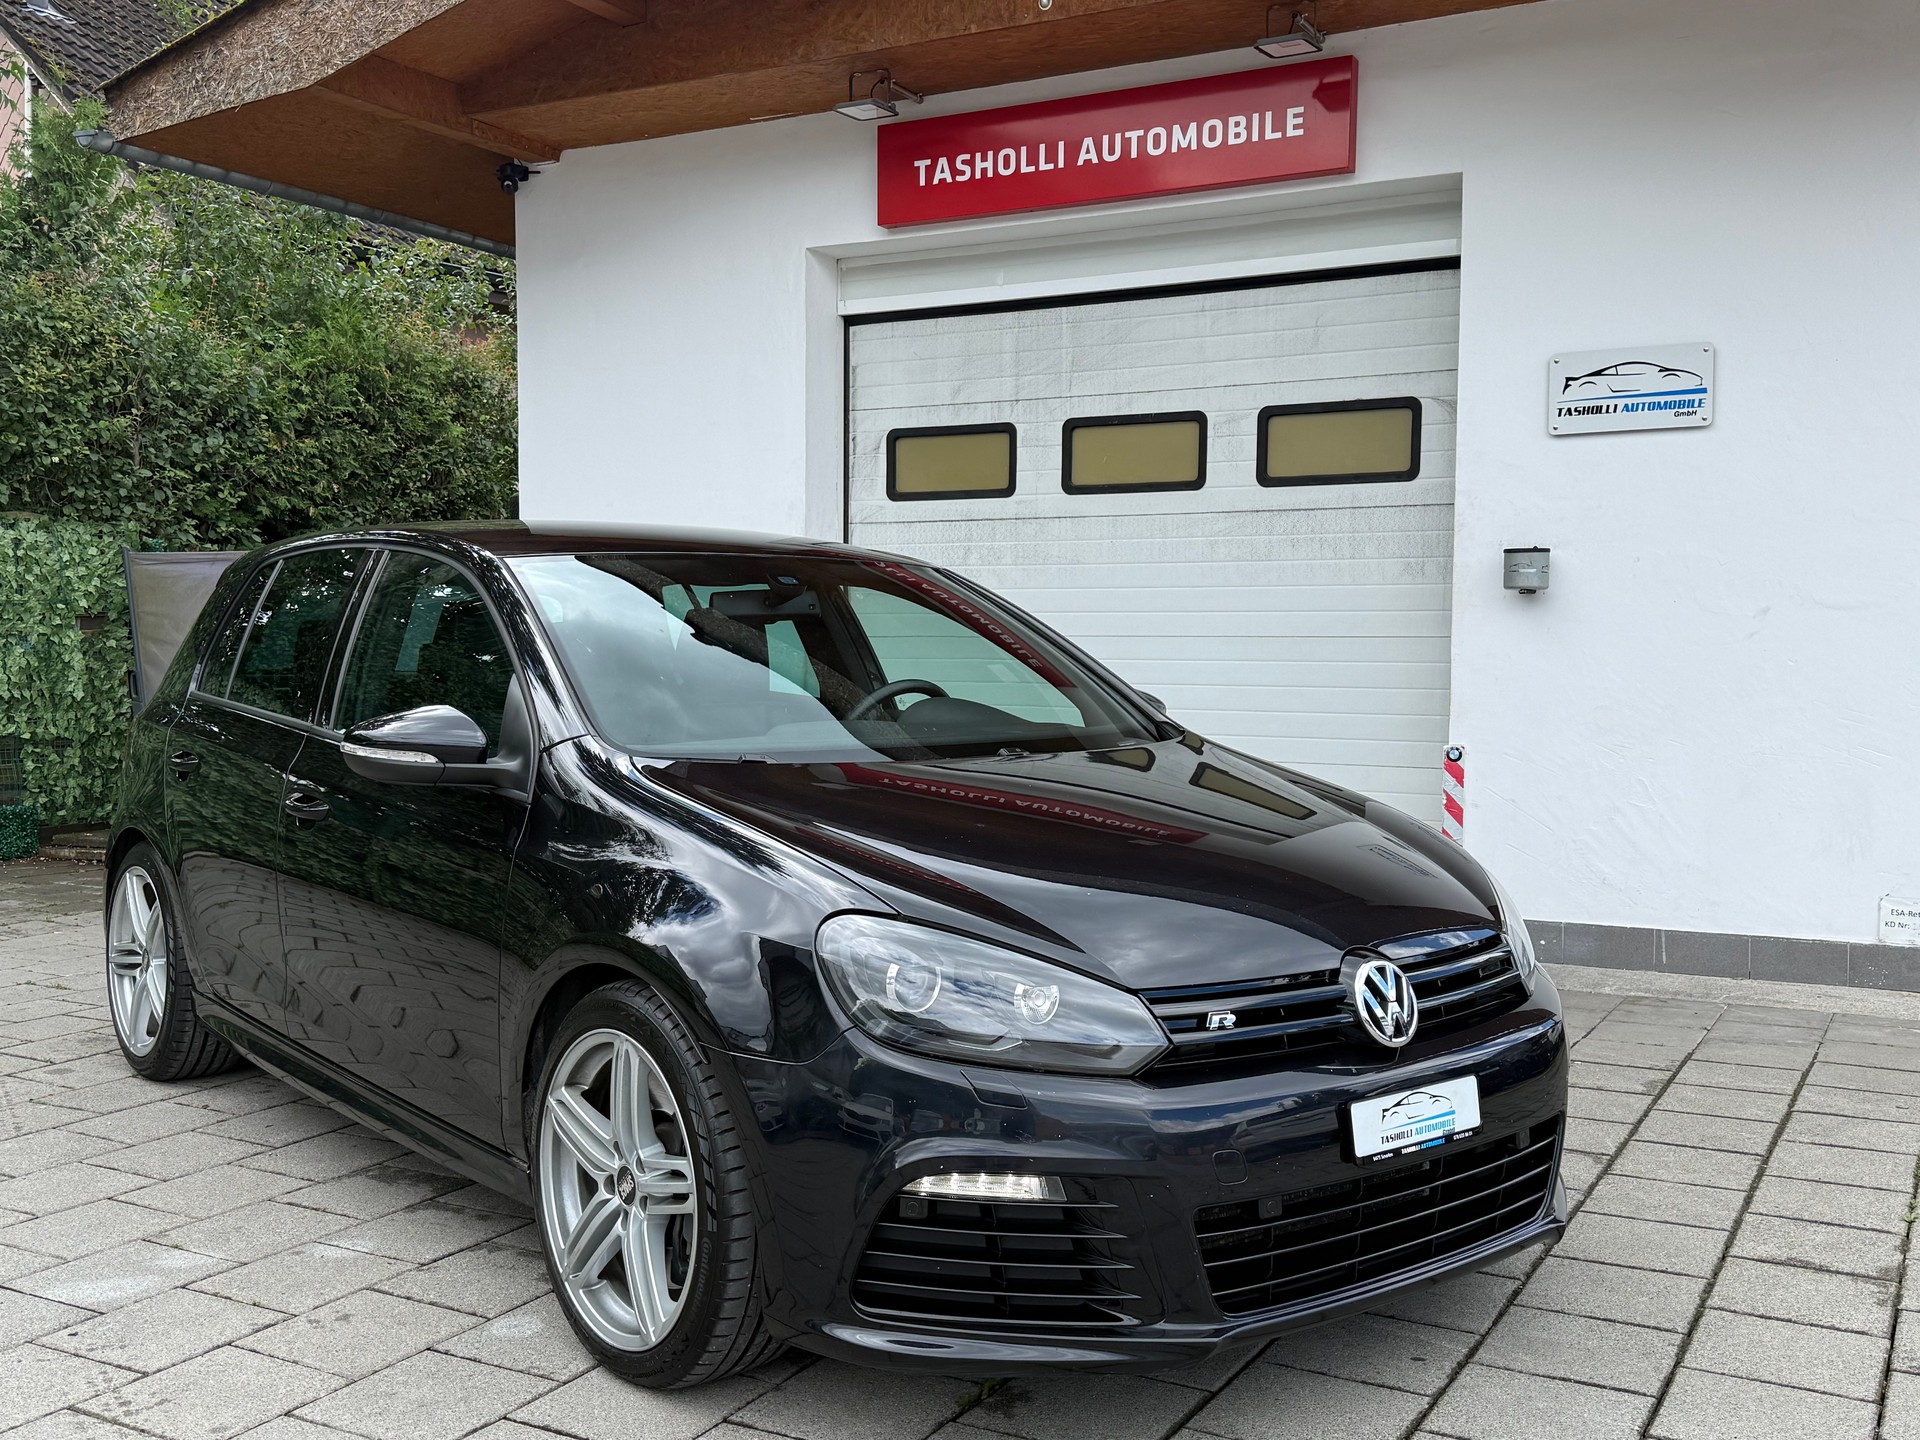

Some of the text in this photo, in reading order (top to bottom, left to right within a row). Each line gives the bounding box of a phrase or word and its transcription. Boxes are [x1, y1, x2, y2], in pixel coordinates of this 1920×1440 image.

[914, 106, 1305, 187] TASHOLLI AUTOMOBILE
[1557, 398, 1706, 417] TASHOLLI AUTOMOBILE
[1674, 410, 1698, 418] GmbH
[1898, 922, 1910, 930] Nr:
[1206, 1011, 1237, 1031] R
[1381, 1129, 1413, 1145] TASHOLLI
[1414, 1117, 1456, 1136] AUTOMOBILE
